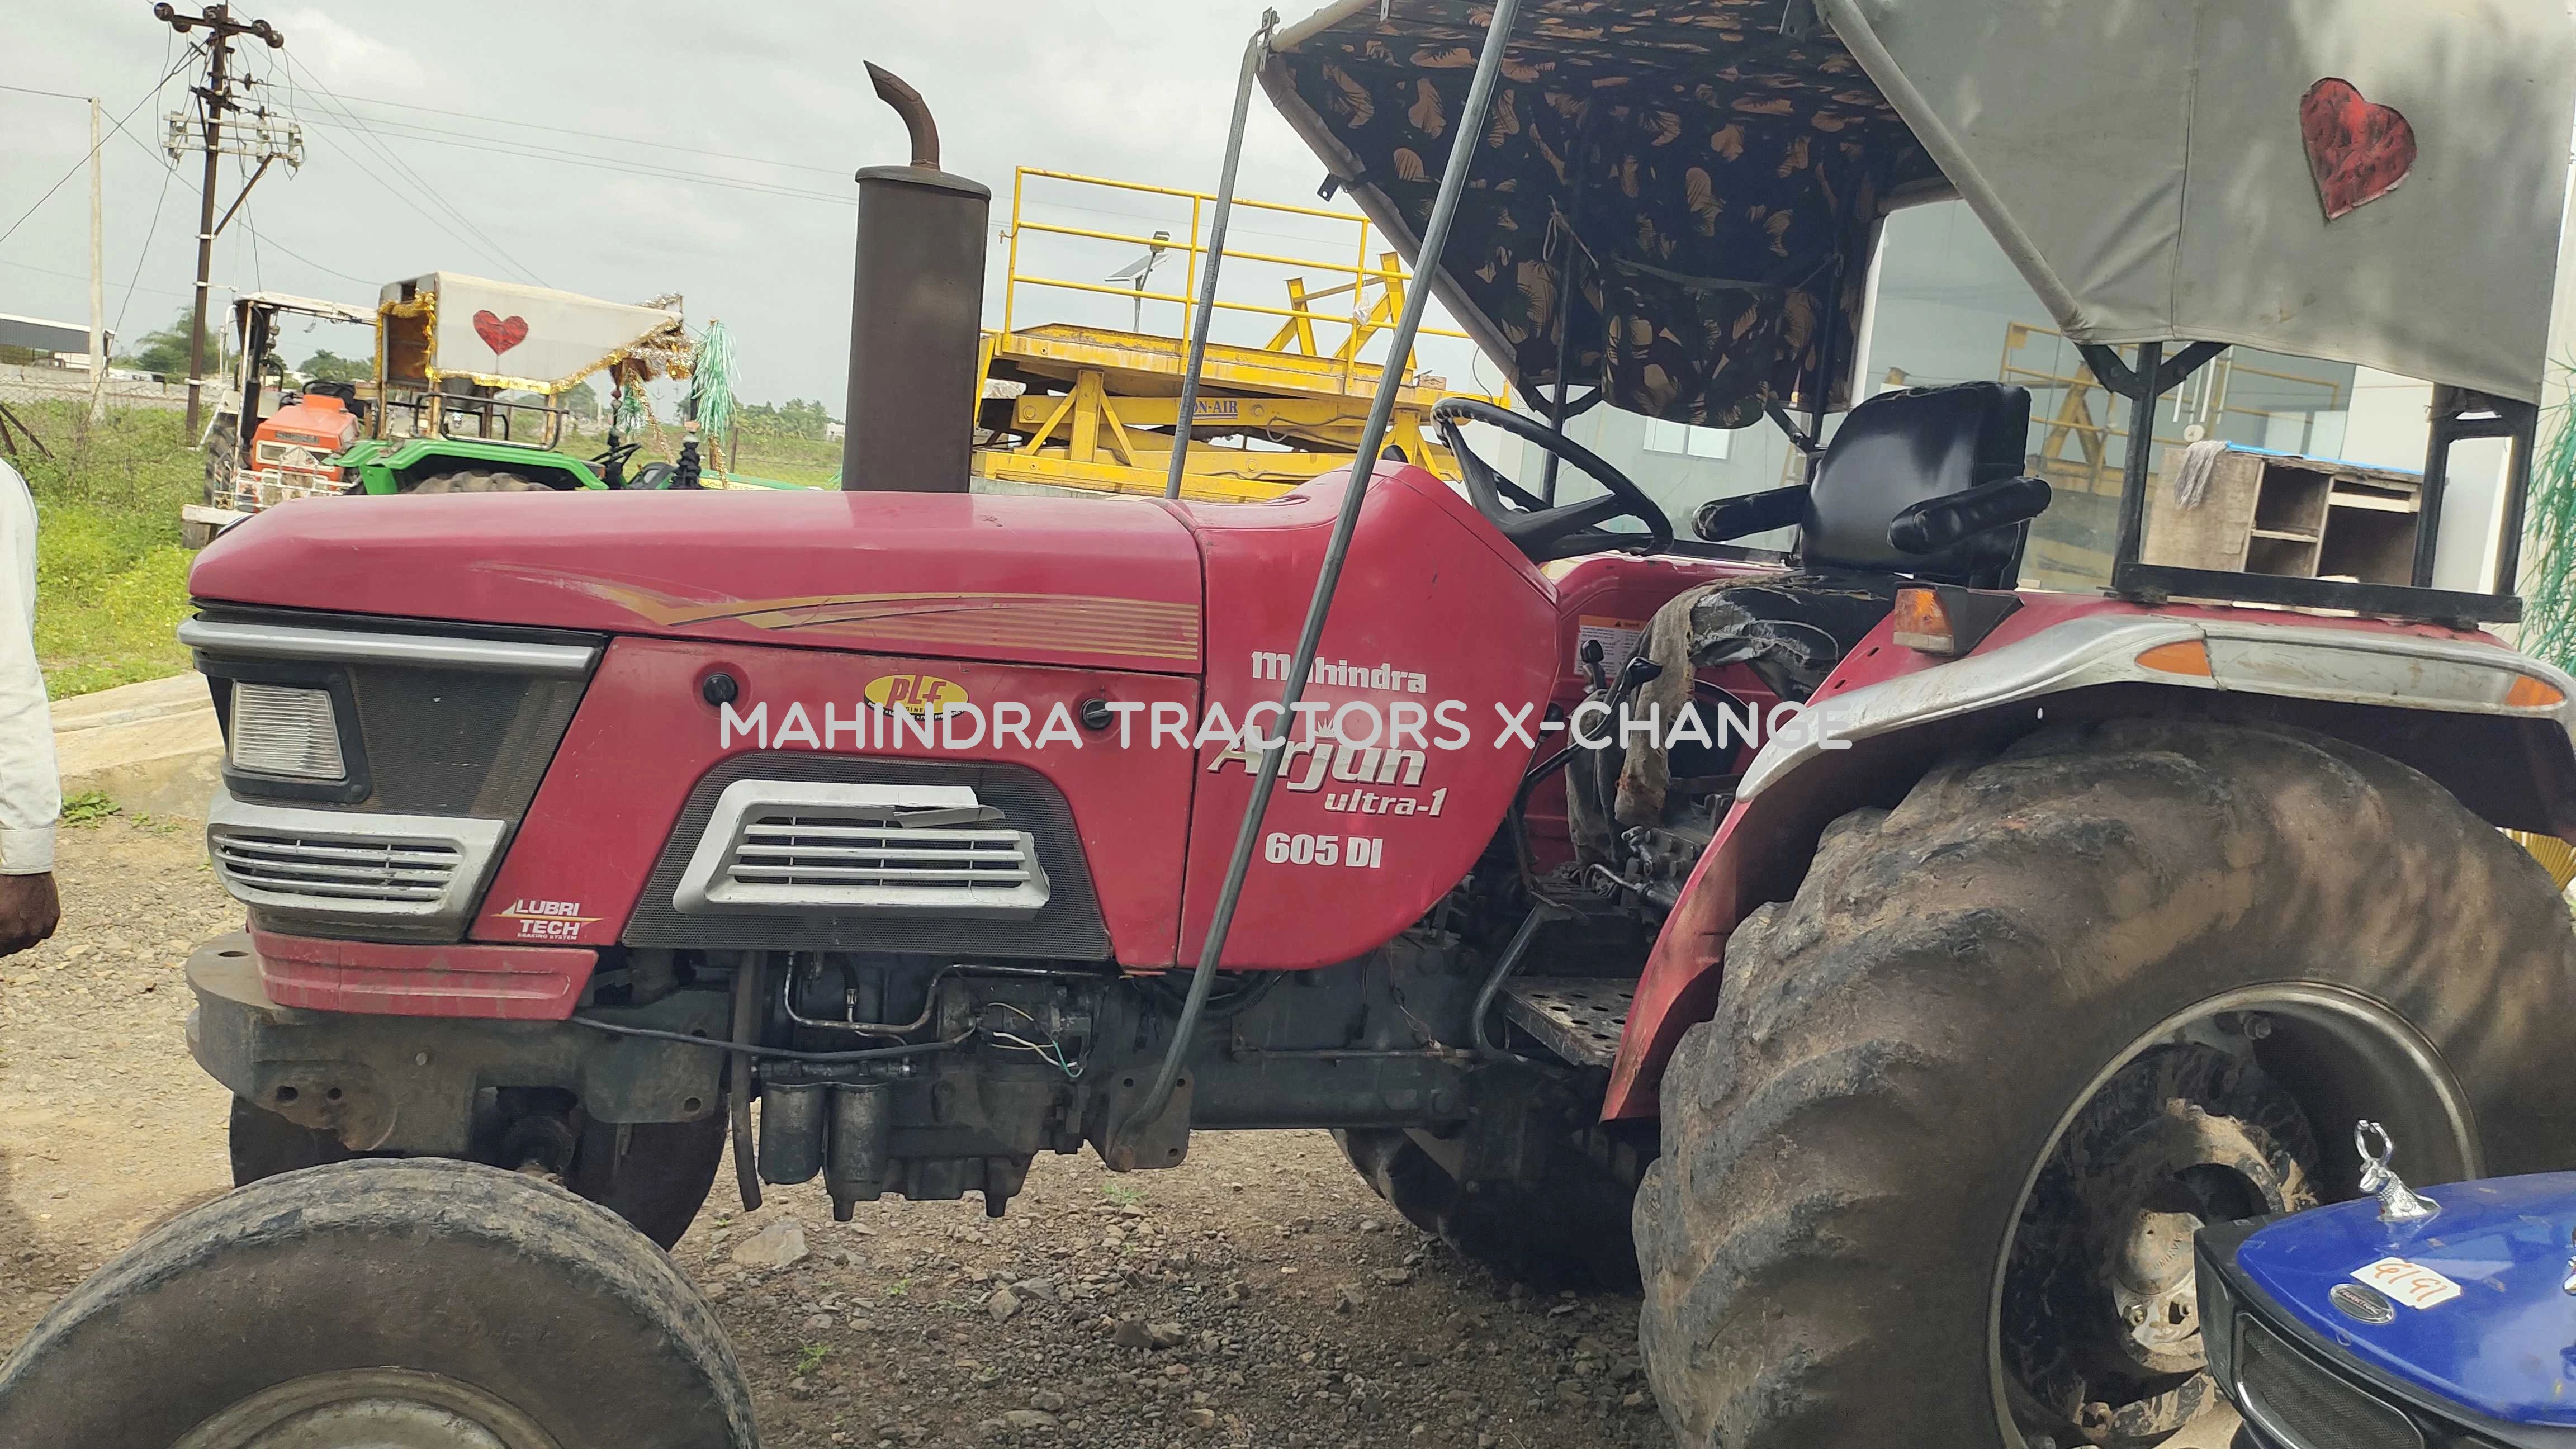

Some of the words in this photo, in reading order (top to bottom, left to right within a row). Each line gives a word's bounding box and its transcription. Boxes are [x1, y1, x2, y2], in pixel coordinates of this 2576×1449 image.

[1251, 651, 1427, 694] Mhindra
[1324, 787, 1447, 817] ultra-1
[1265, 832, 1339, 865] 605
[1345, 837, 1383, 868] DI
[515, 899, 580, 916] LUBRI
[520, 920, 580, 935] TECH
